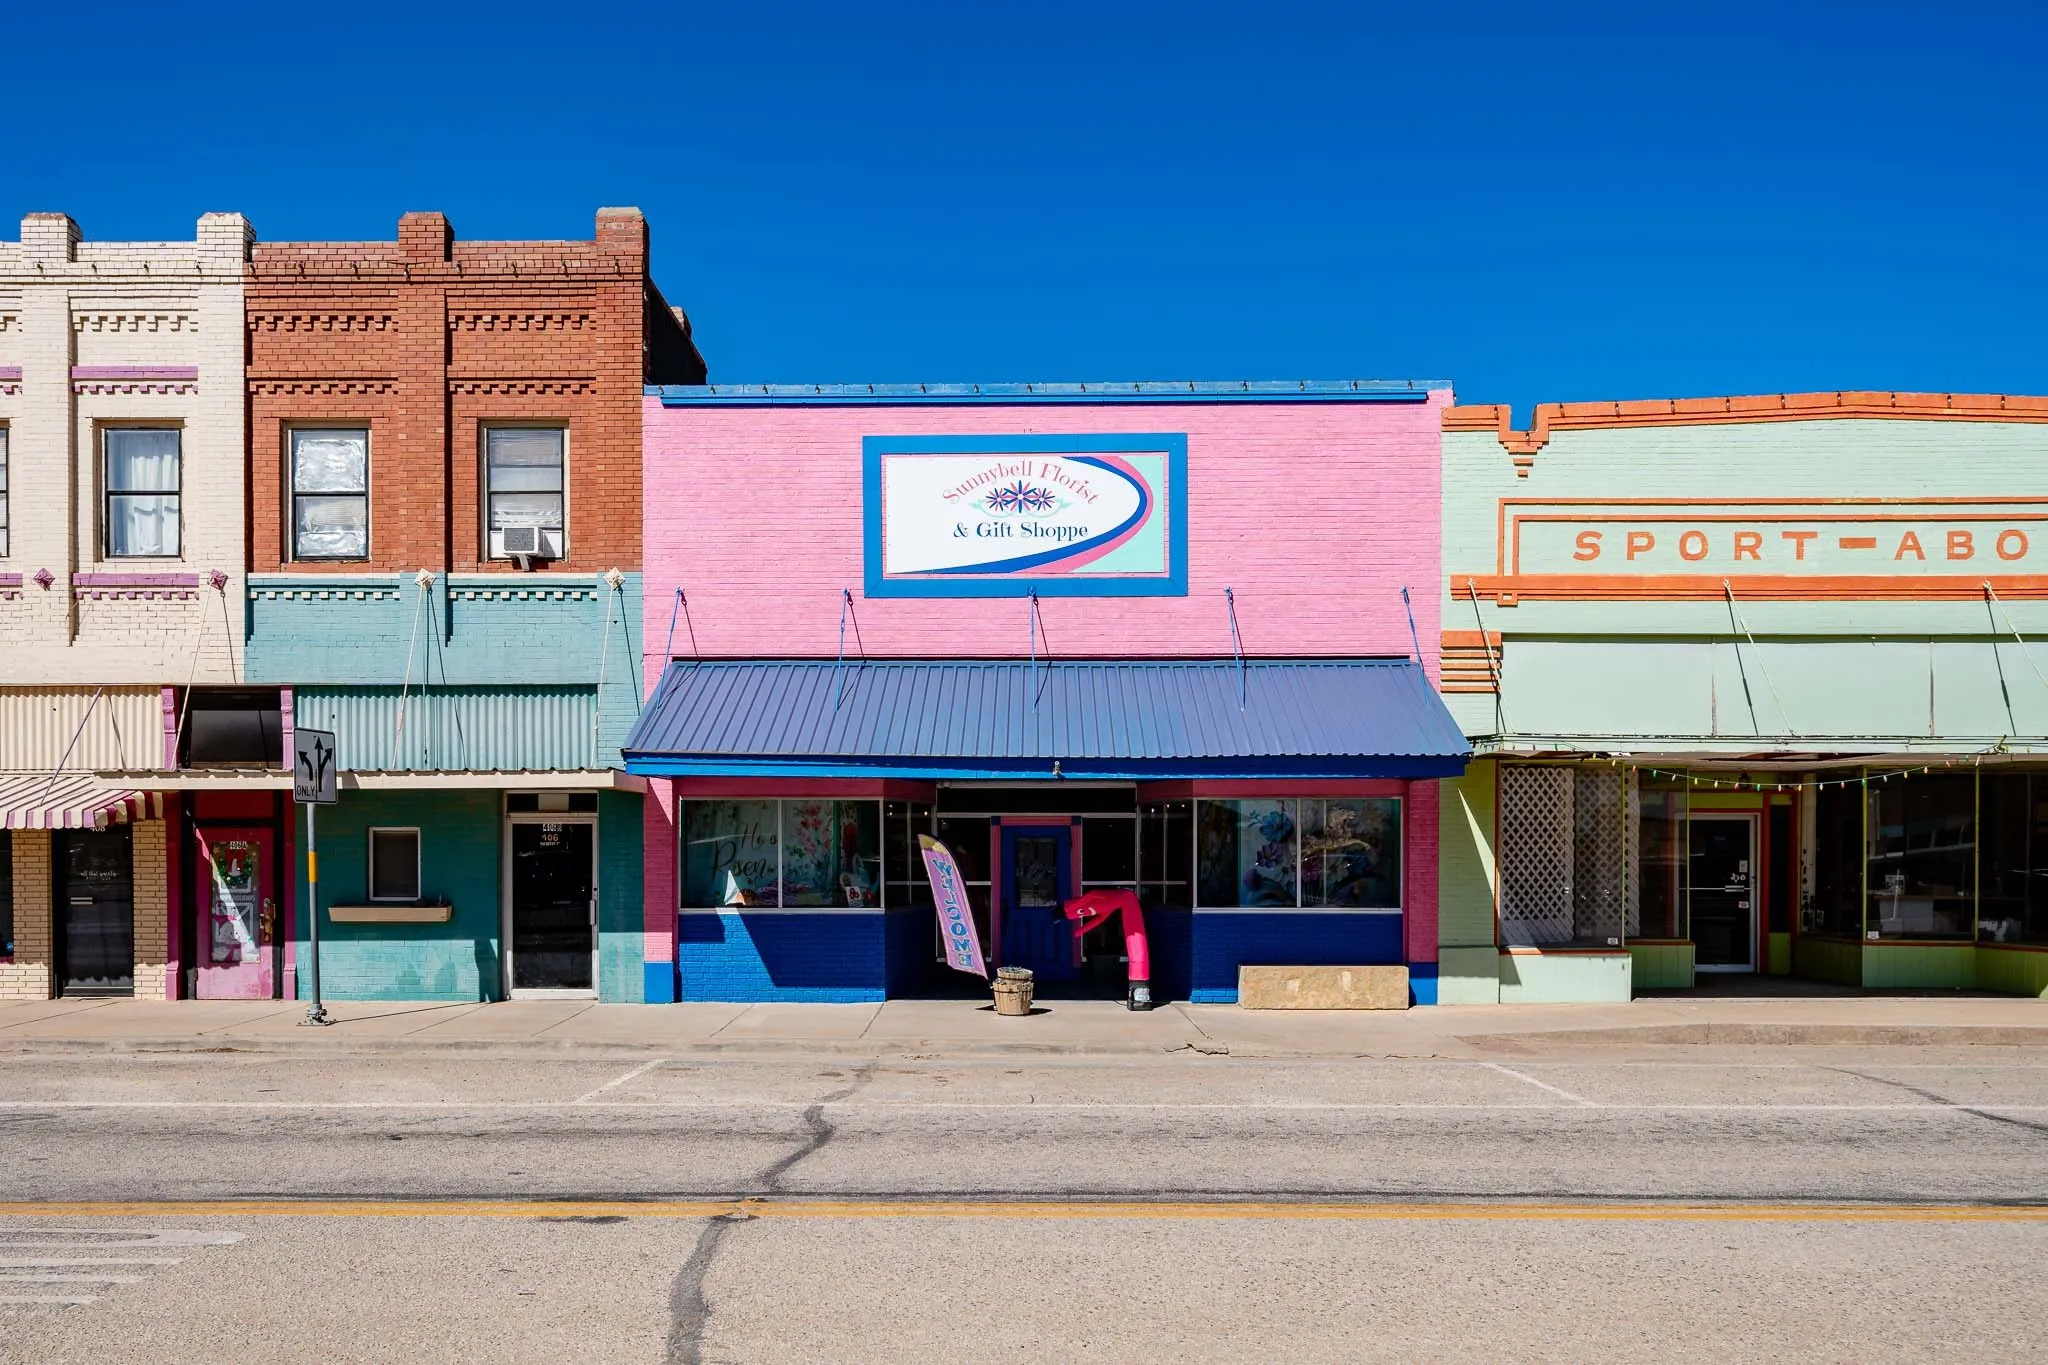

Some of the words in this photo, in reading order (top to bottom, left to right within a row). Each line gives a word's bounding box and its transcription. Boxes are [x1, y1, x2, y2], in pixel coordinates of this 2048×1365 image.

[943, 459, 1032, 504] Sunnybell
[1040, 463, 1101, 505] Florist
[953, 521, 969, 538] &
[976, 521, 1014, 538] Gift
[1020, 521, 1089, 542] Shoppe
[296, 784, 316, 797] ONLY
